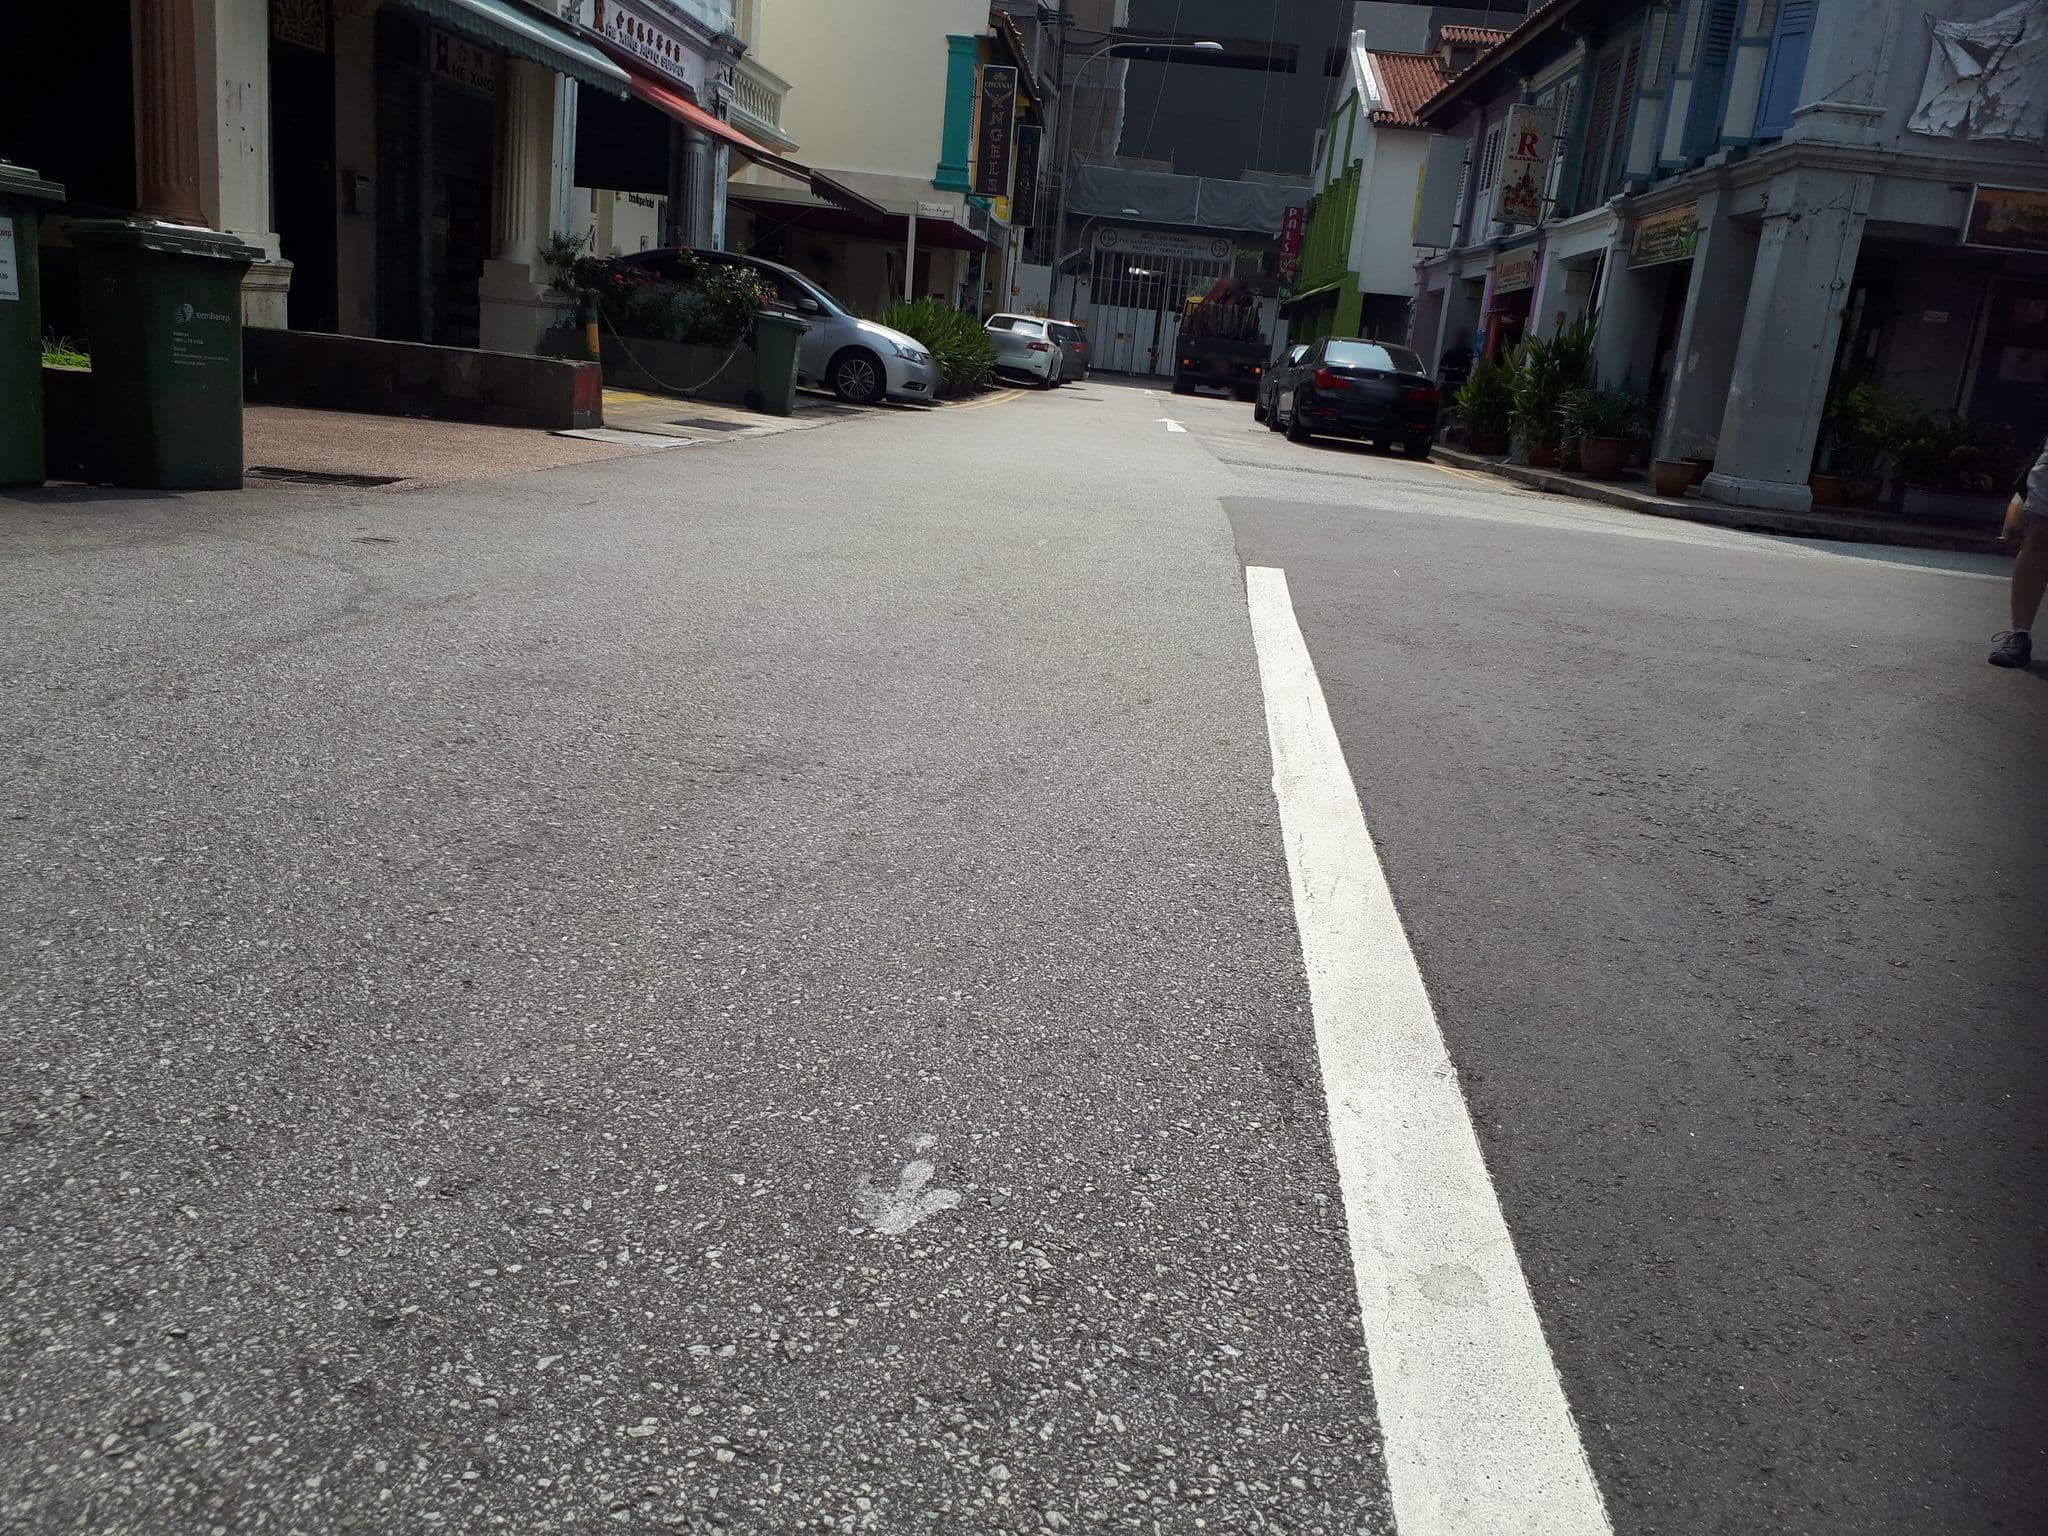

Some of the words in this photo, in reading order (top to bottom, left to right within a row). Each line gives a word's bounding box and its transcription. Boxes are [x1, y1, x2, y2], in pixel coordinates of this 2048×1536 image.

[605, 23, 616, 40] HE
[618, 31, 639, 53] XING
[639, 43, 659, 65] AUTO
[660, 54, 686, 78] SUPPLY
[470, 71, 496, 92] XING
[1284, 207, 1298, 253] PALS
[195, 312, 231, 323] sembcorp
